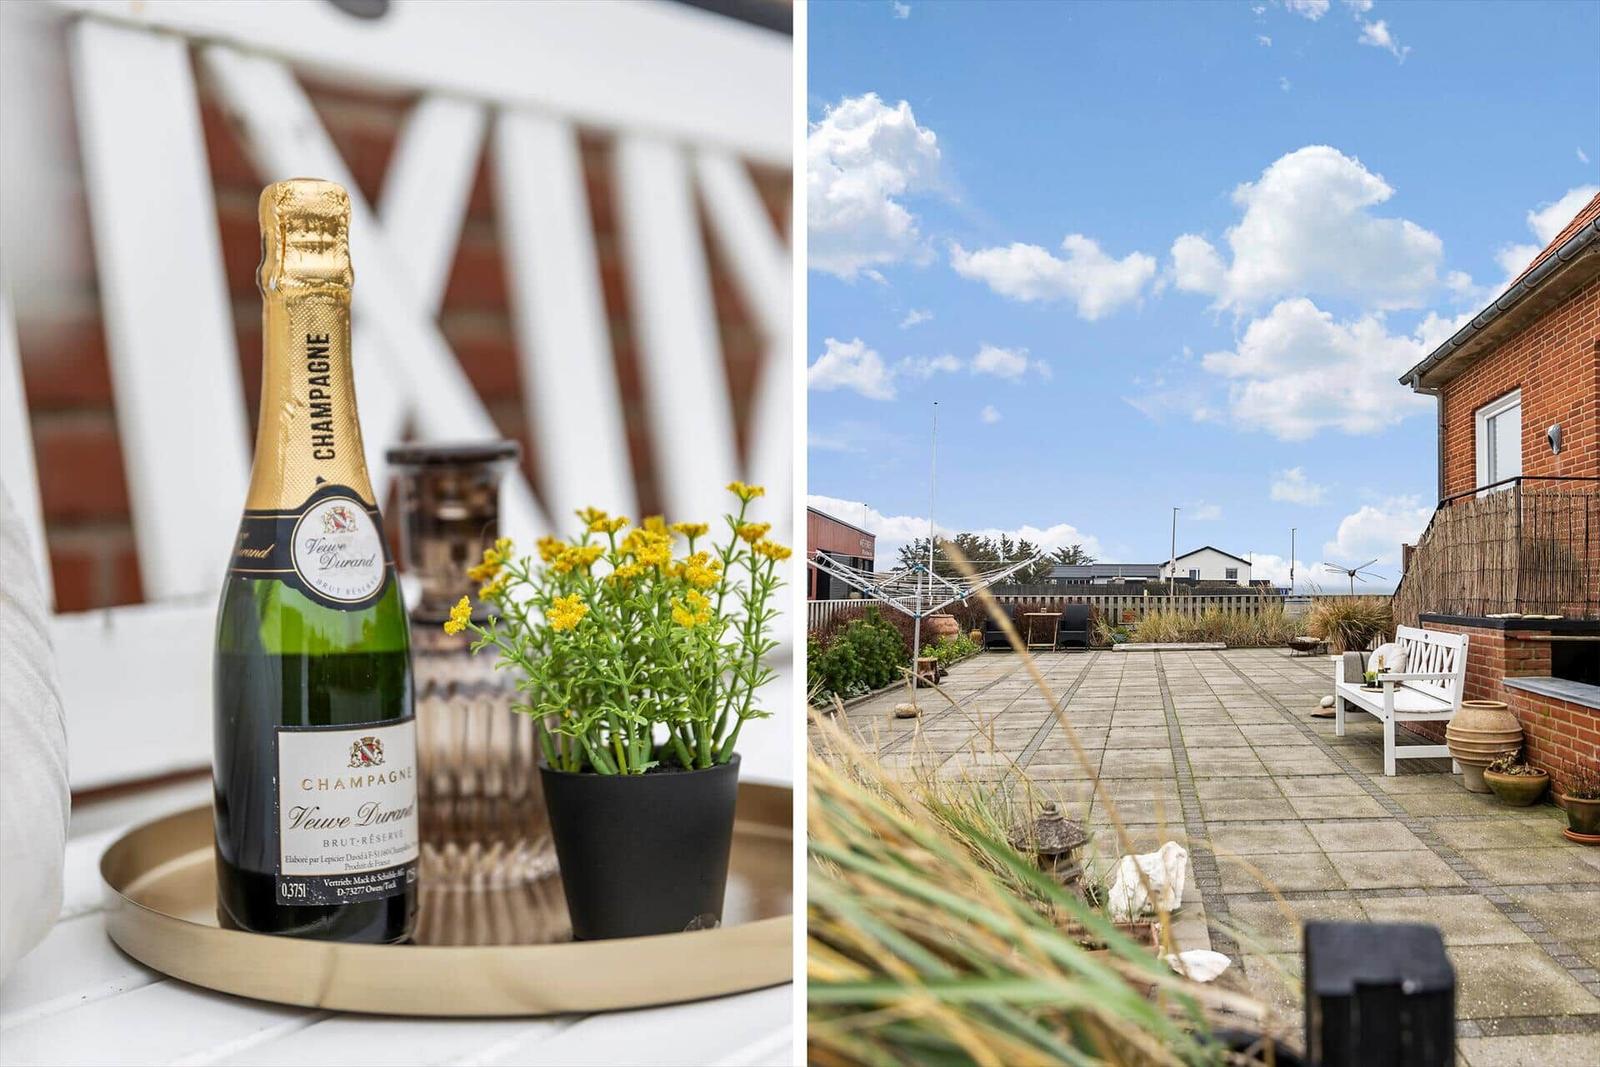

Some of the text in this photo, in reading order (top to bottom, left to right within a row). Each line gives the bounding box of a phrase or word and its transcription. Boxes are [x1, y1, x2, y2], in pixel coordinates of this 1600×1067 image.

[307, 333, 336, 460] CHAMPAGNE
[304, 536, 347, 556] Veuve
[318, 553, 376, 571] Durand
[301, 766, 413, 791] CHAMPAGNE
[288, 797, 416, 831] Veuve Durand
